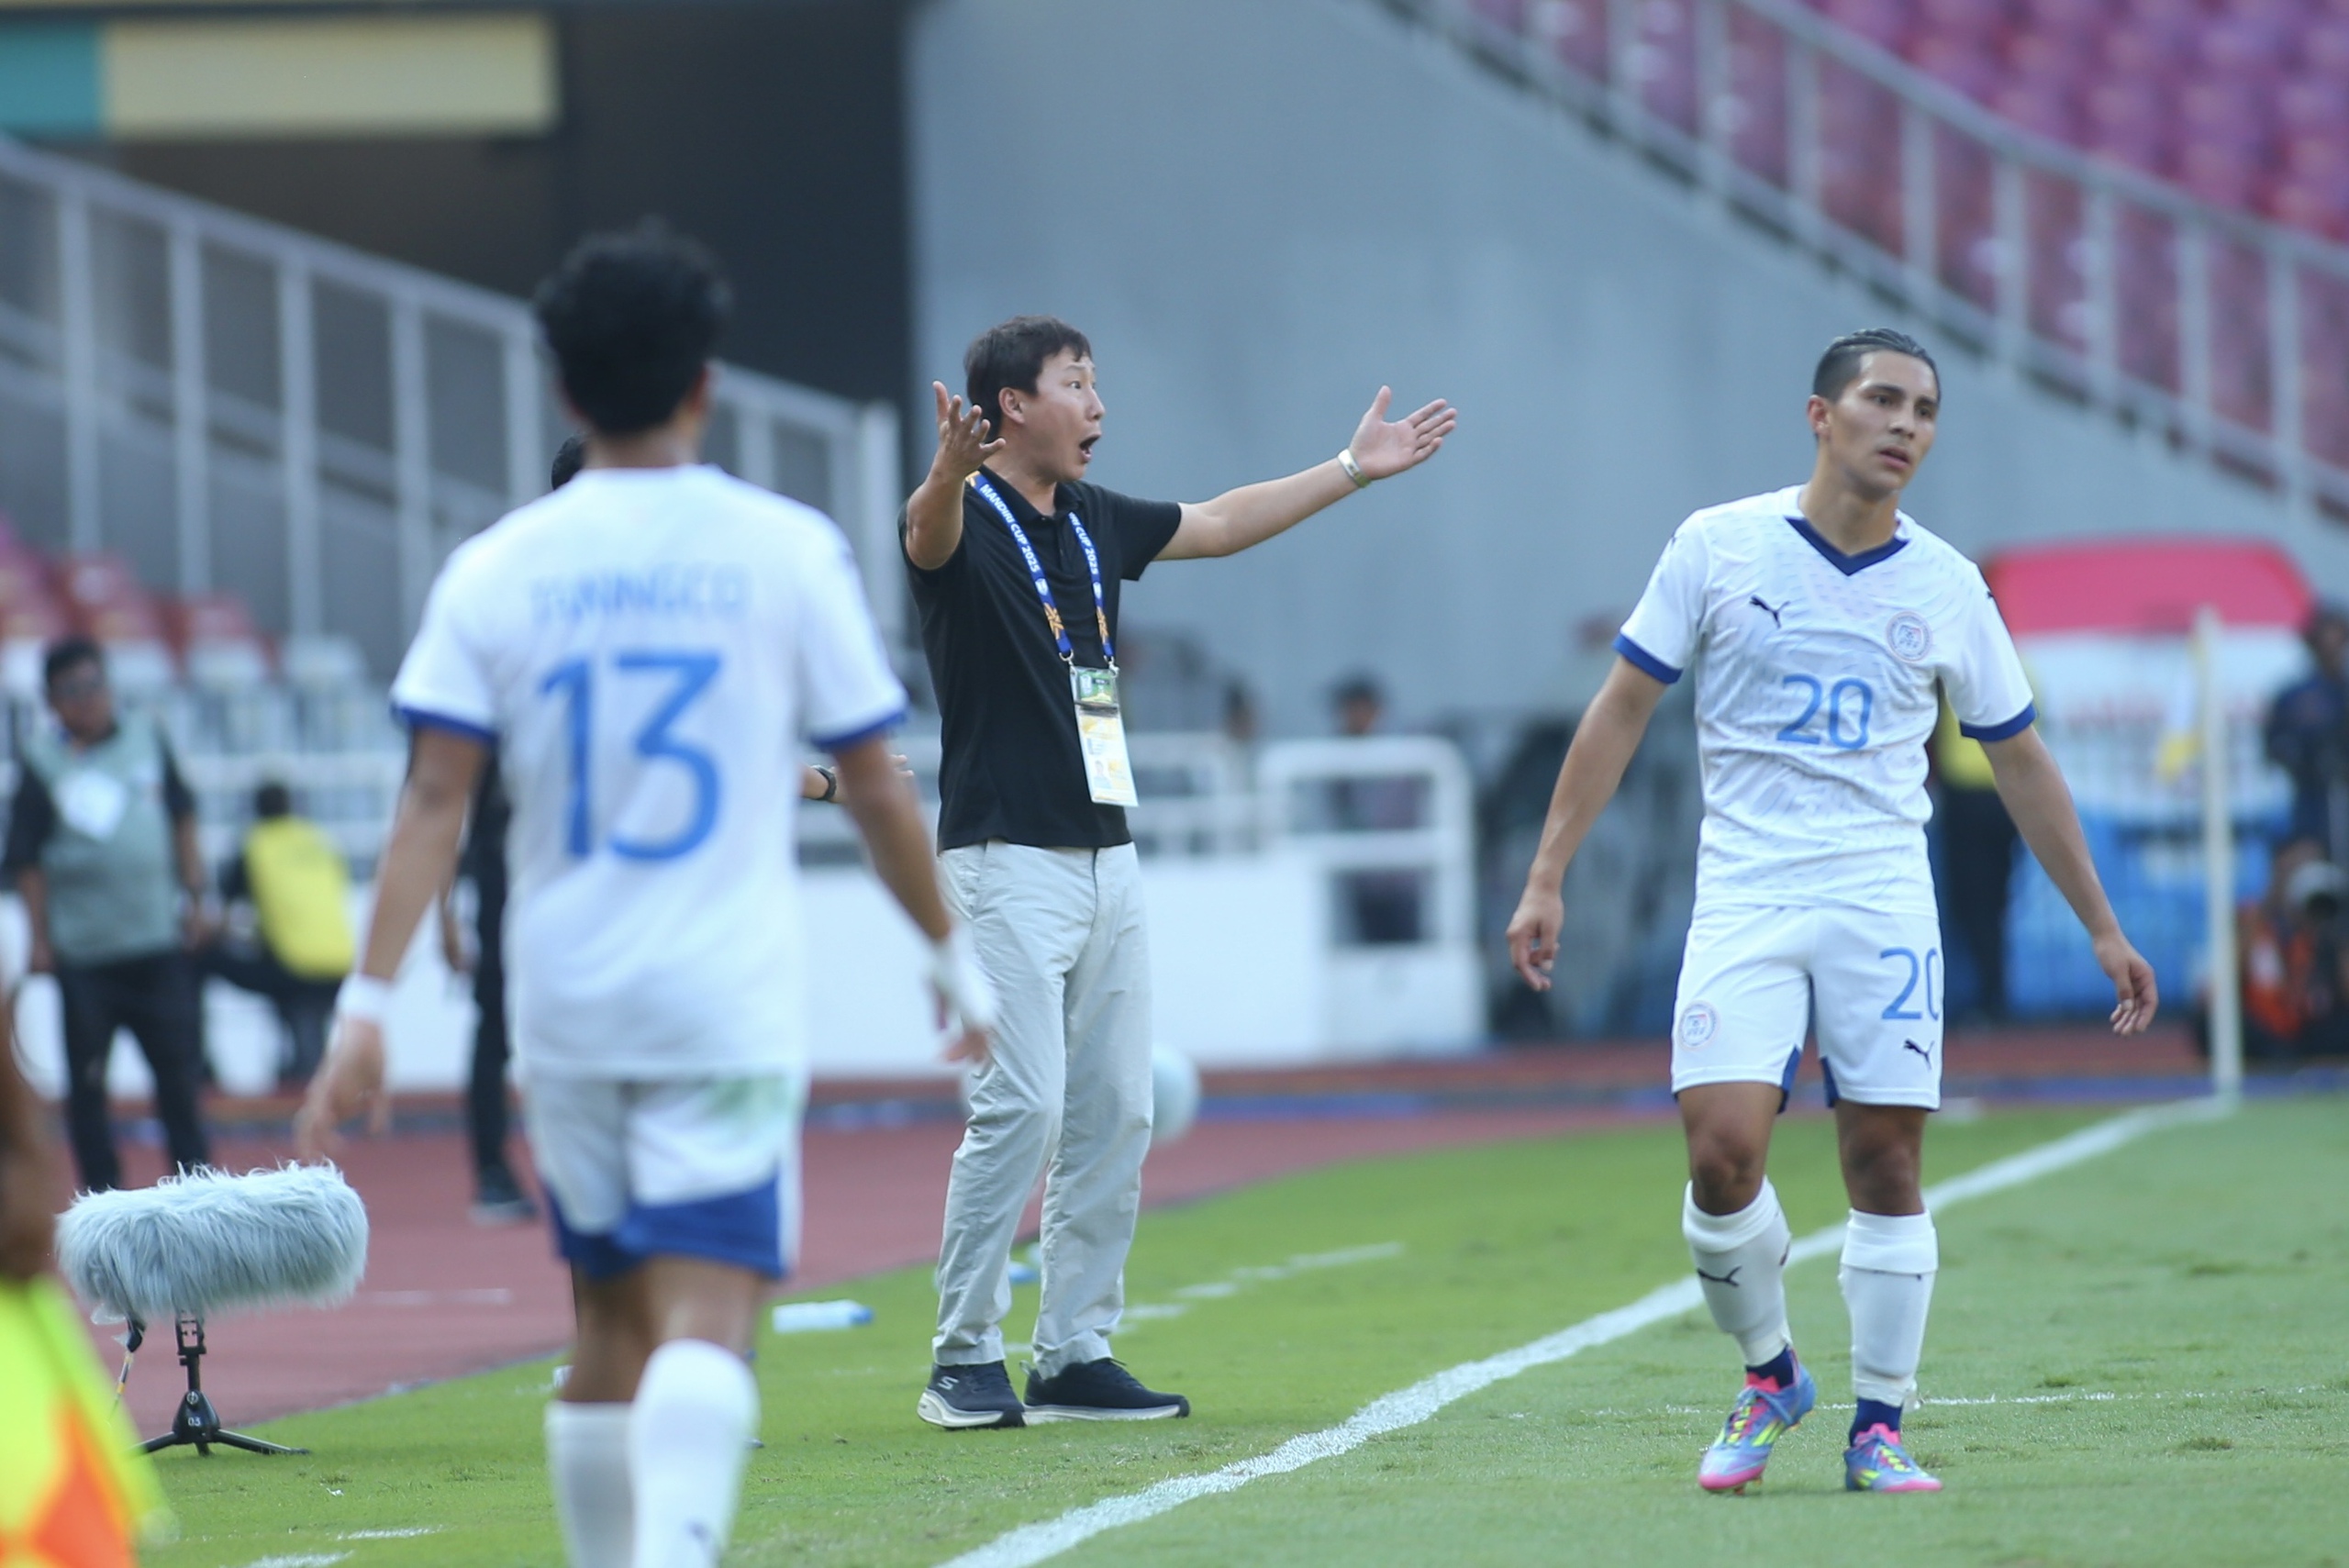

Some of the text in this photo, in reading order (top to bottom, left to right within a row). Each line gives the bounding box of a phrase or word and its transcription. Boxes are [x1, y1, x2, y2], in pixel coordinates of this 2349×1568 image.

[980, 484, 1041, 573] MANDIRI CUP 2025
[1075, 526, 1092, 547] CUP
[1085, 548, 1099, 574] 2025
[1776, 673, 1874, 751] 20
[536, 650, 723, 862] 13
